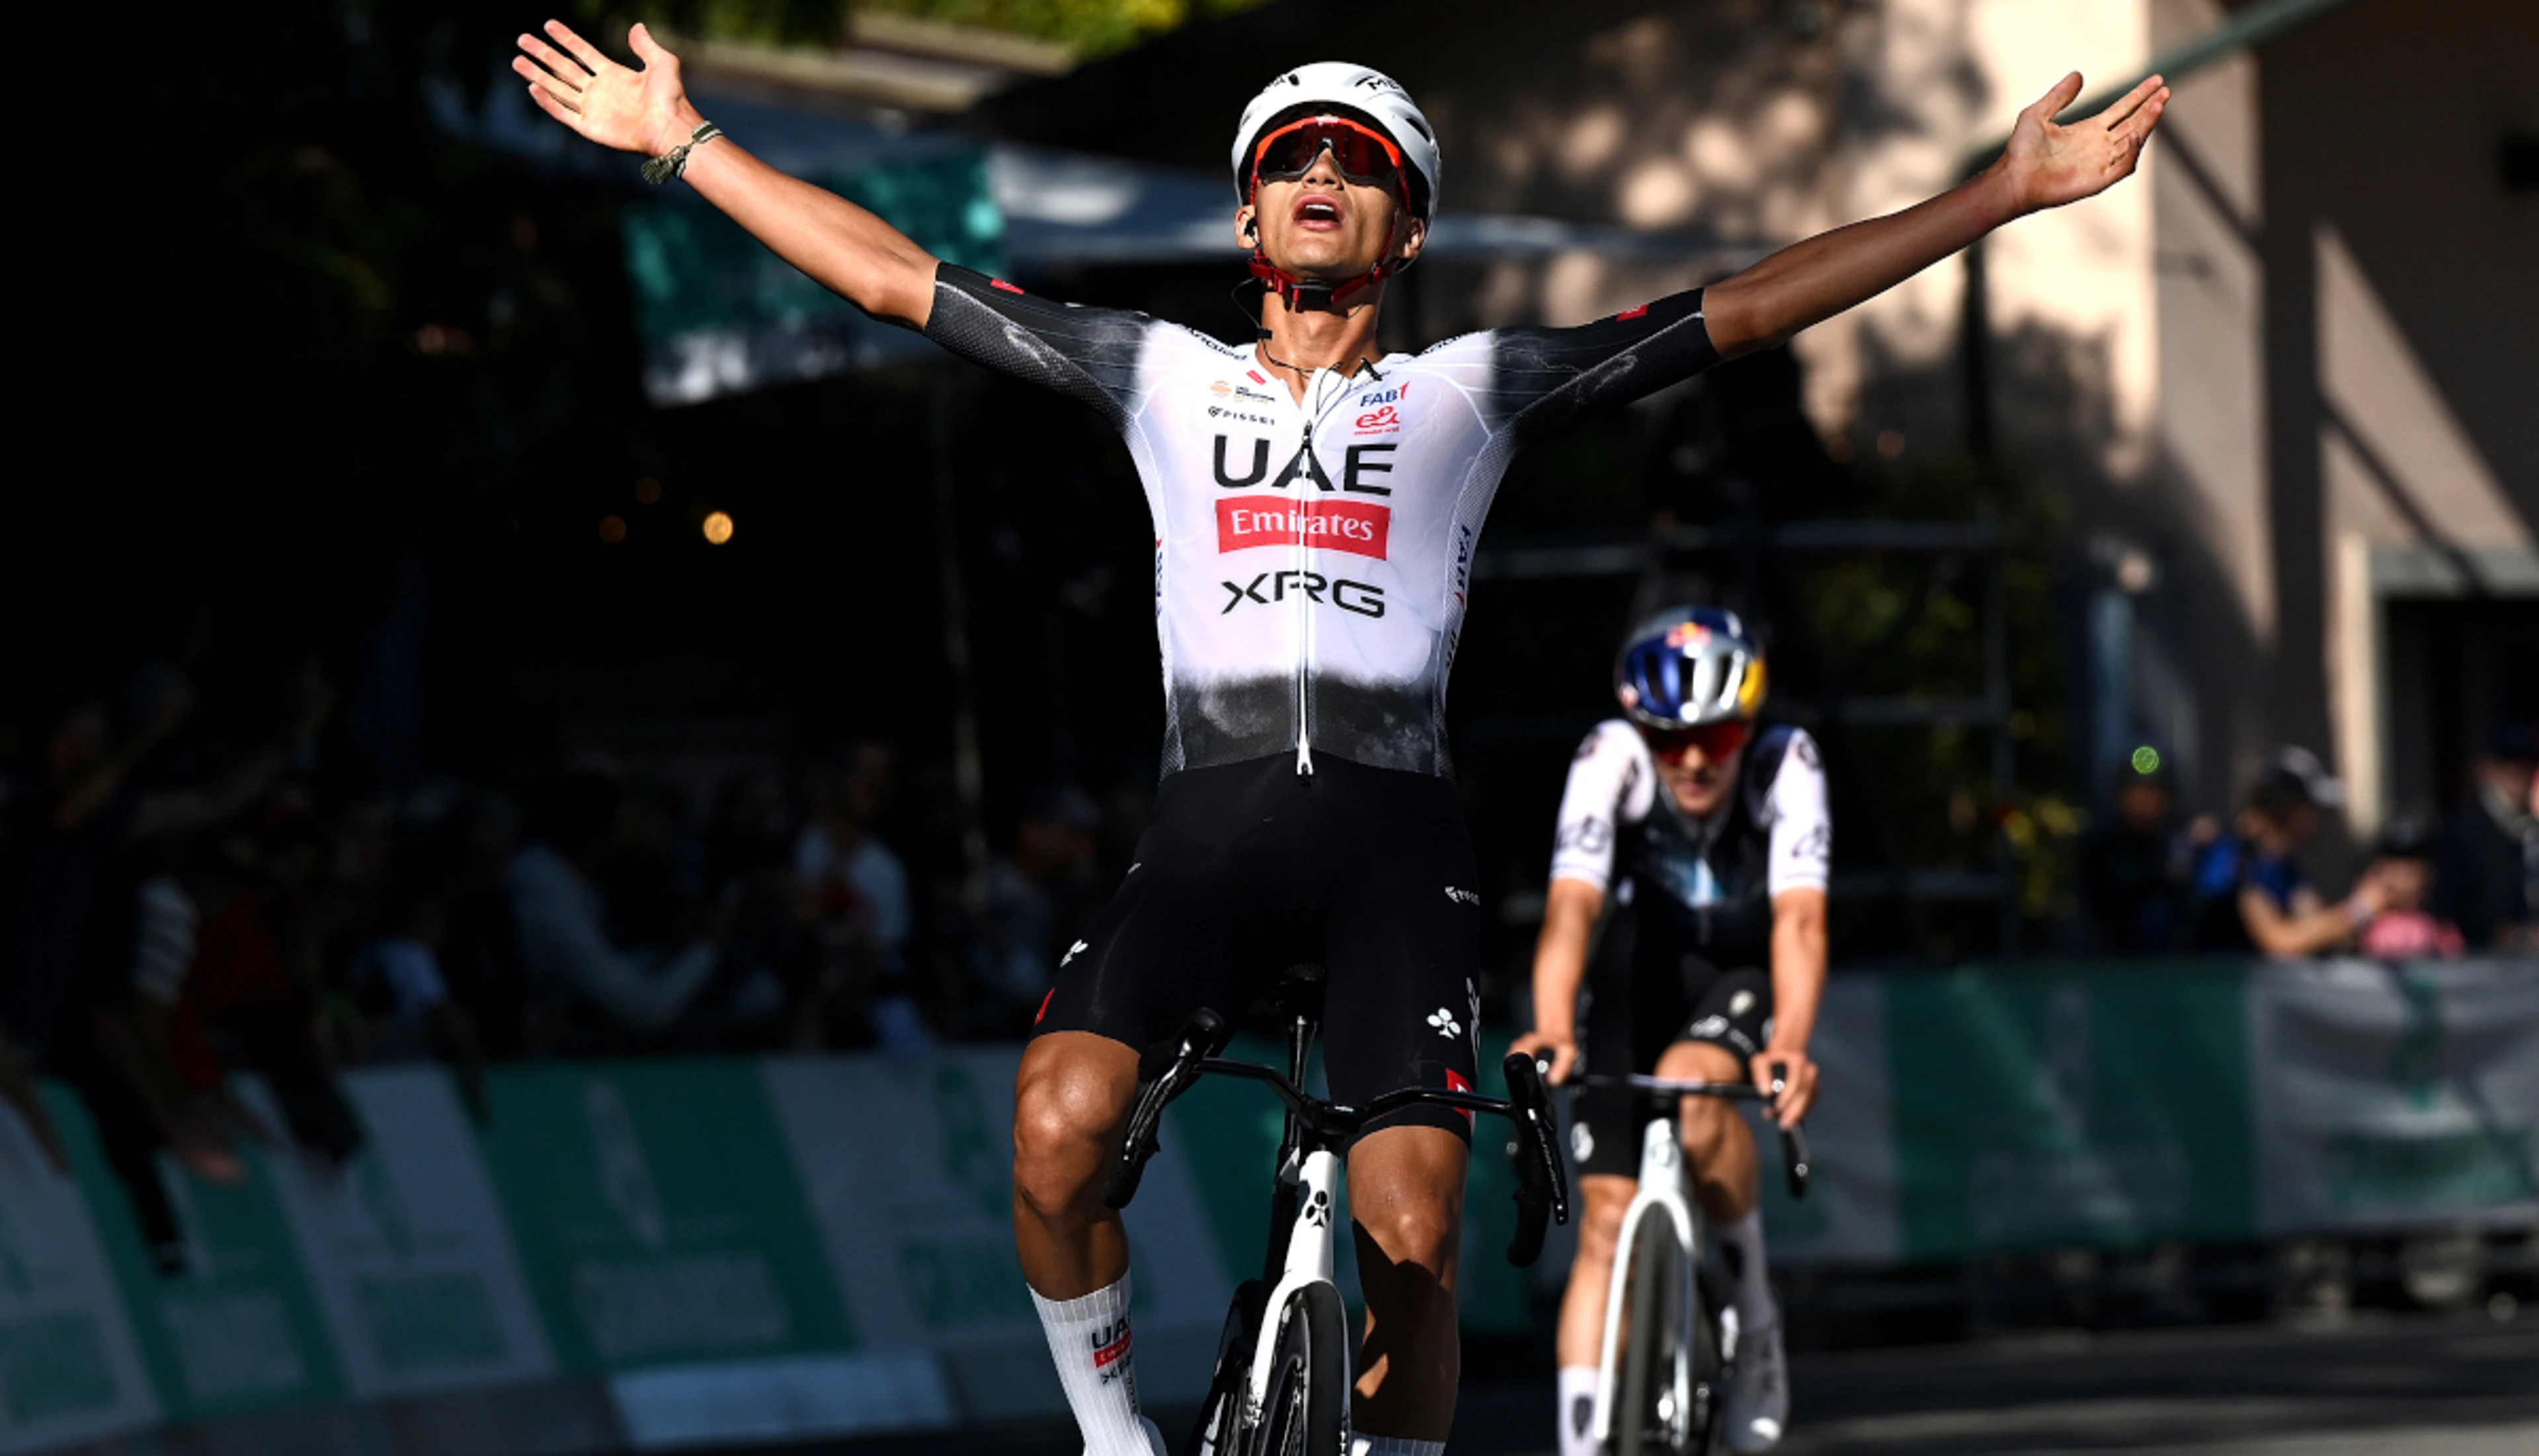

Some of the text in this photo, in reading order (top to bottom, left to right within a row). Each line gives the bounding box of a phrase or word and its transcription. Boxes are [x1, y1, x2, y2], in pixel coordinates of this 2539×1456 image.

[1213, 434, 1397, 497] UAE
[1231, 508, 1375, 541] Emirates
[1221, 569, 1385, 619] XRG
[1092, 1313, 1130, 1349] UA
